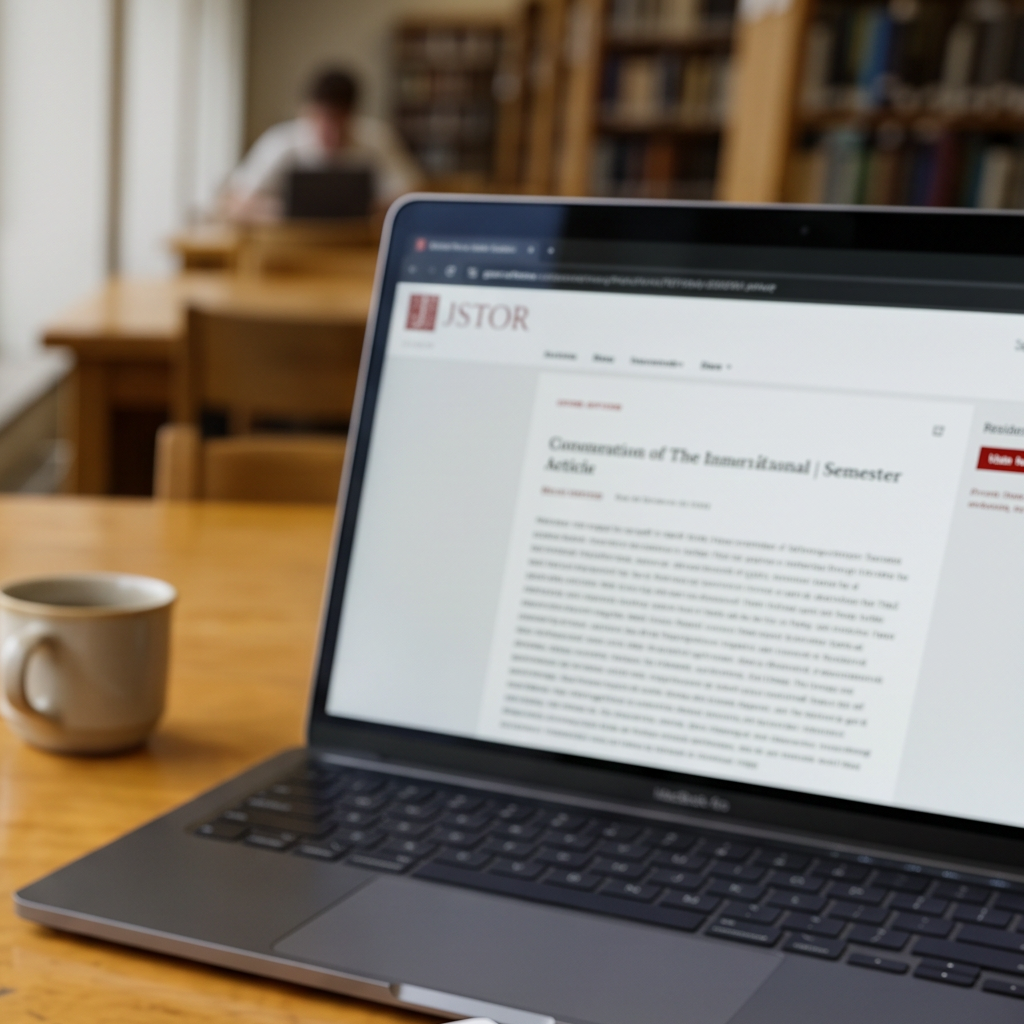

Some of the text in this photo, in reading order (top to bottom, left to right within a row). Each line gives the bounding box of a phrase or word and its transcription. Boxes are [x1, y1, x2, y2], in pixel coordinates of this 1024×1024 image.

[442, 301, 530, 332] JSTOR
[669, 445, 700, 466] The
[823, 460, 903, 484] Semester
